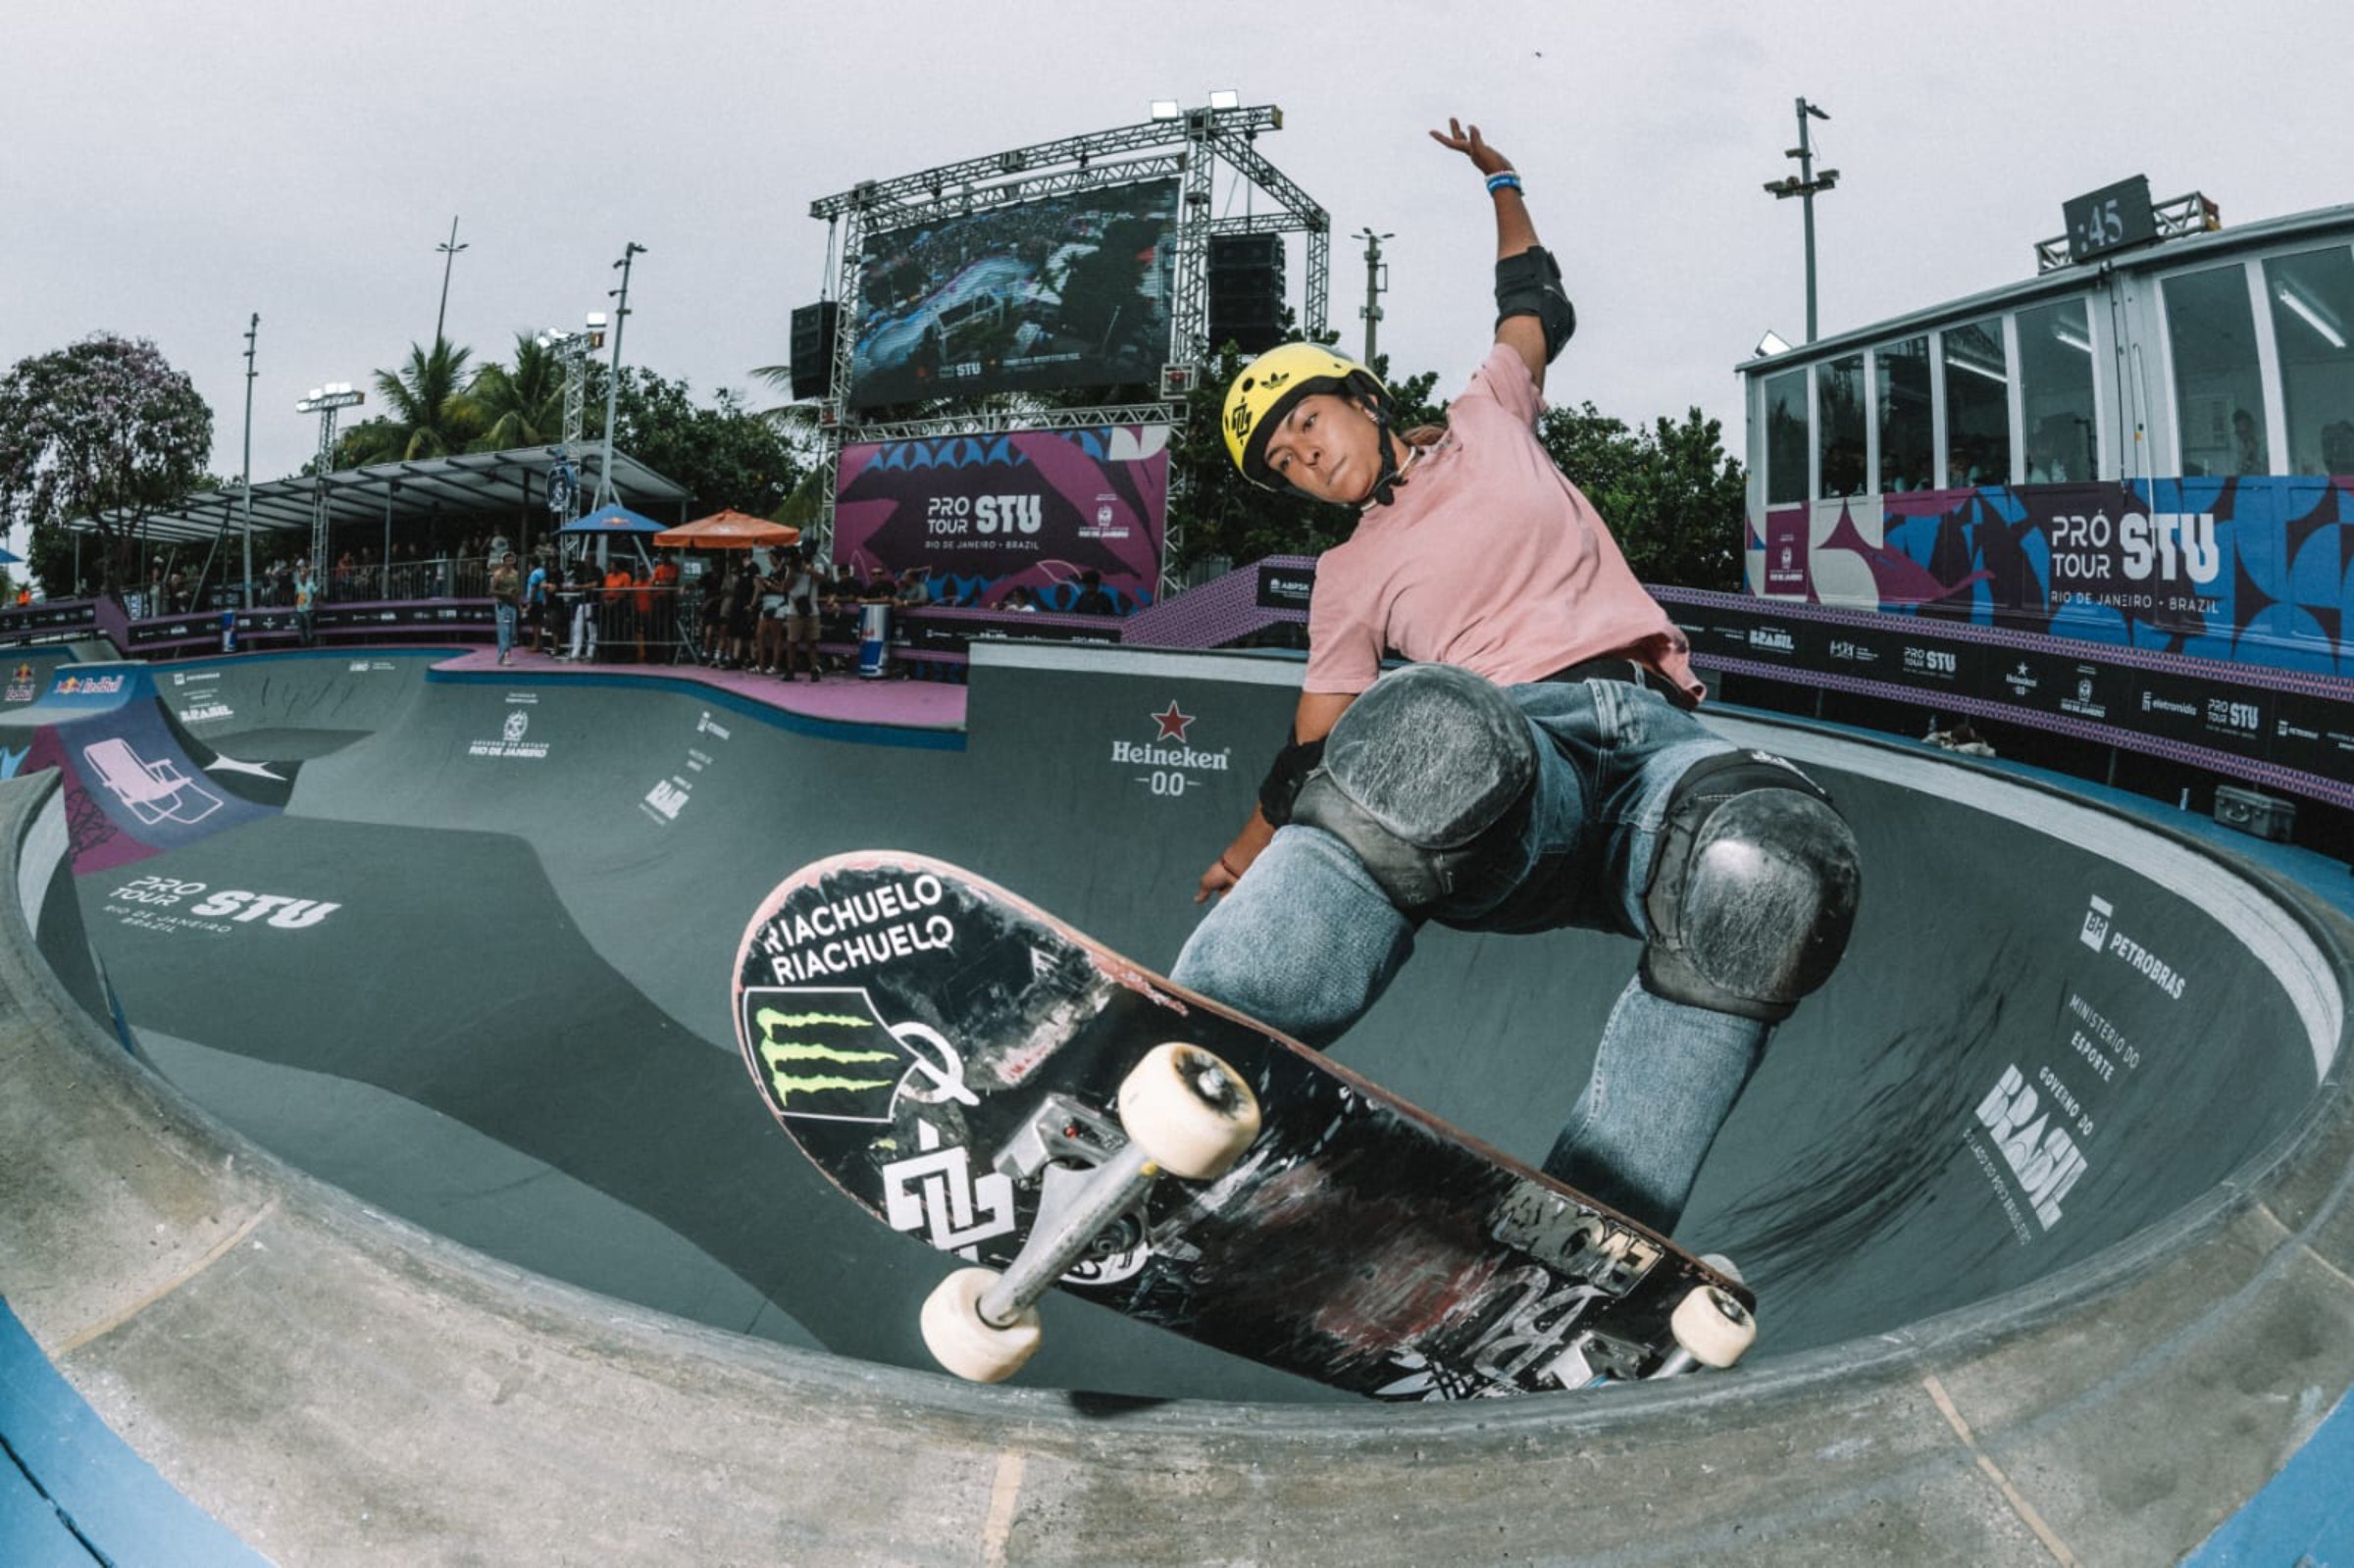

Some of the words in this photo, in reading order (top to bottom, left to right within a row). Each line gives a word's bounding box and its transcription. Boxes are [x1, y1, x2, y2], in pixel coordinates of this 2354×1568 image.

[928, 497, 970, 517] PRO
[975, 494, 1042, 535] STU
[928, 519, 969, 534] TOUR
[925, 540, 941, 550] RIO
[943, 540, 953, 550] DE
[956, 540, 996, 550] JANEIRO
[1005, 540, 1040, 551] BRAZIL
[2120, 512, 2220, 584] STU
[2052, 553, 2111, 580] TOUR
[2051, 590, 2072, 604] RIO
[2075, 592, 2092, 606] DE
[2095, 593, 2152, 609] JANEIRO
[2169, 597, 2220, 614] BRAZIL
[1926, 650, 1957, 672] STU
[2229, 702, 2259, 730] STU
[1111, 740, 1228, 771] Heineken
[109, 887, 180, 906] TOUR
[128, 876, 207, 895] PRO
[190, 890, 342, 929] STU
[763, 875, 943, 955] RIACHUELO
[772, 915, 954, 986] RIACHUELO
[2109, 932, 2186, 999] PETROBRAS
[2071, 1031, 2116, 1083] ESPORTE
[2123, 1046, 2140, 1070] DO
[2039, 1066, 2079, 1118] GOVERNO
[2077, 1113, 2095, 1137] DO
[1974, 1063, 2088, 1232] BRASIL
